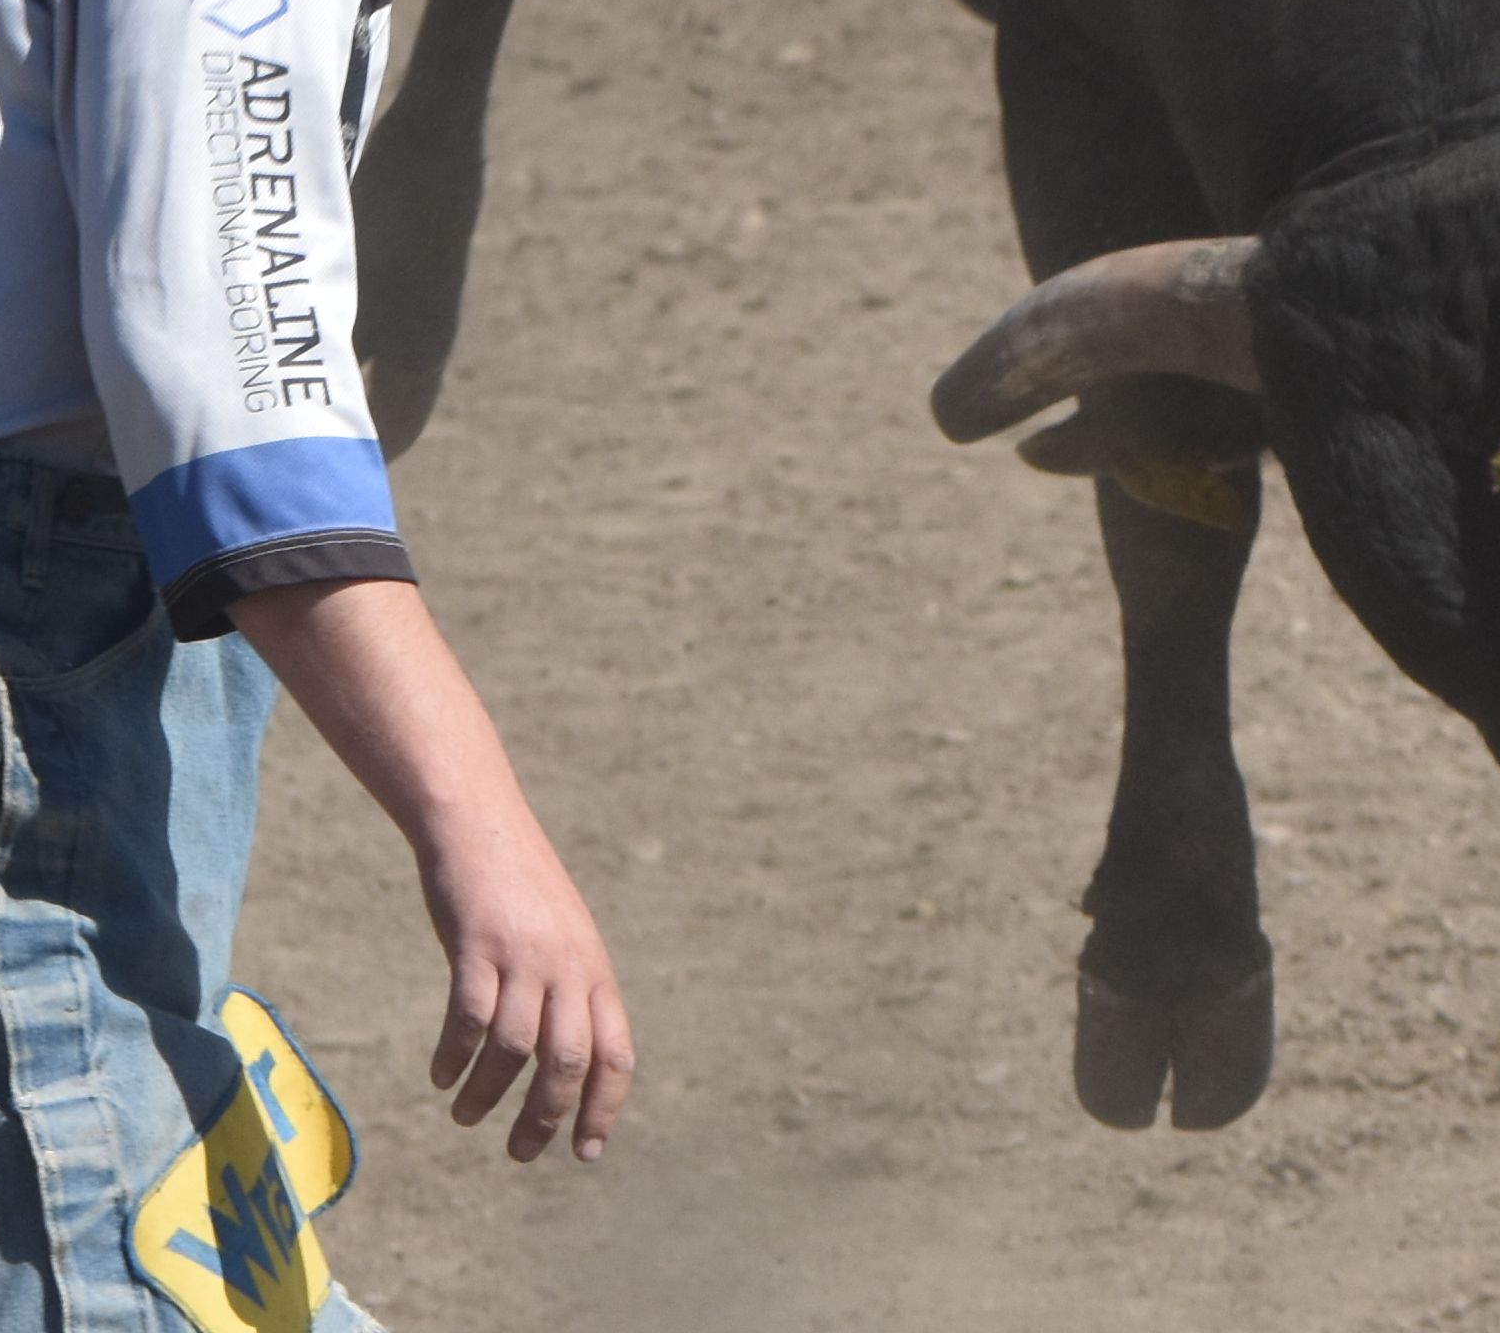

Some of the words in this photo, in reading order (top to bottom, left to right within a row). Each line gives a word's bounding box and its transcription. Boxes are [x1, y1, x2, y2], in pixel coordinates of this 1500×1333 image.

[202, 51, 249, 276] DIRECTIONAL
[239, 53, 332, 408] ADRENALINE
[225, 283, 278, 414] BORING
